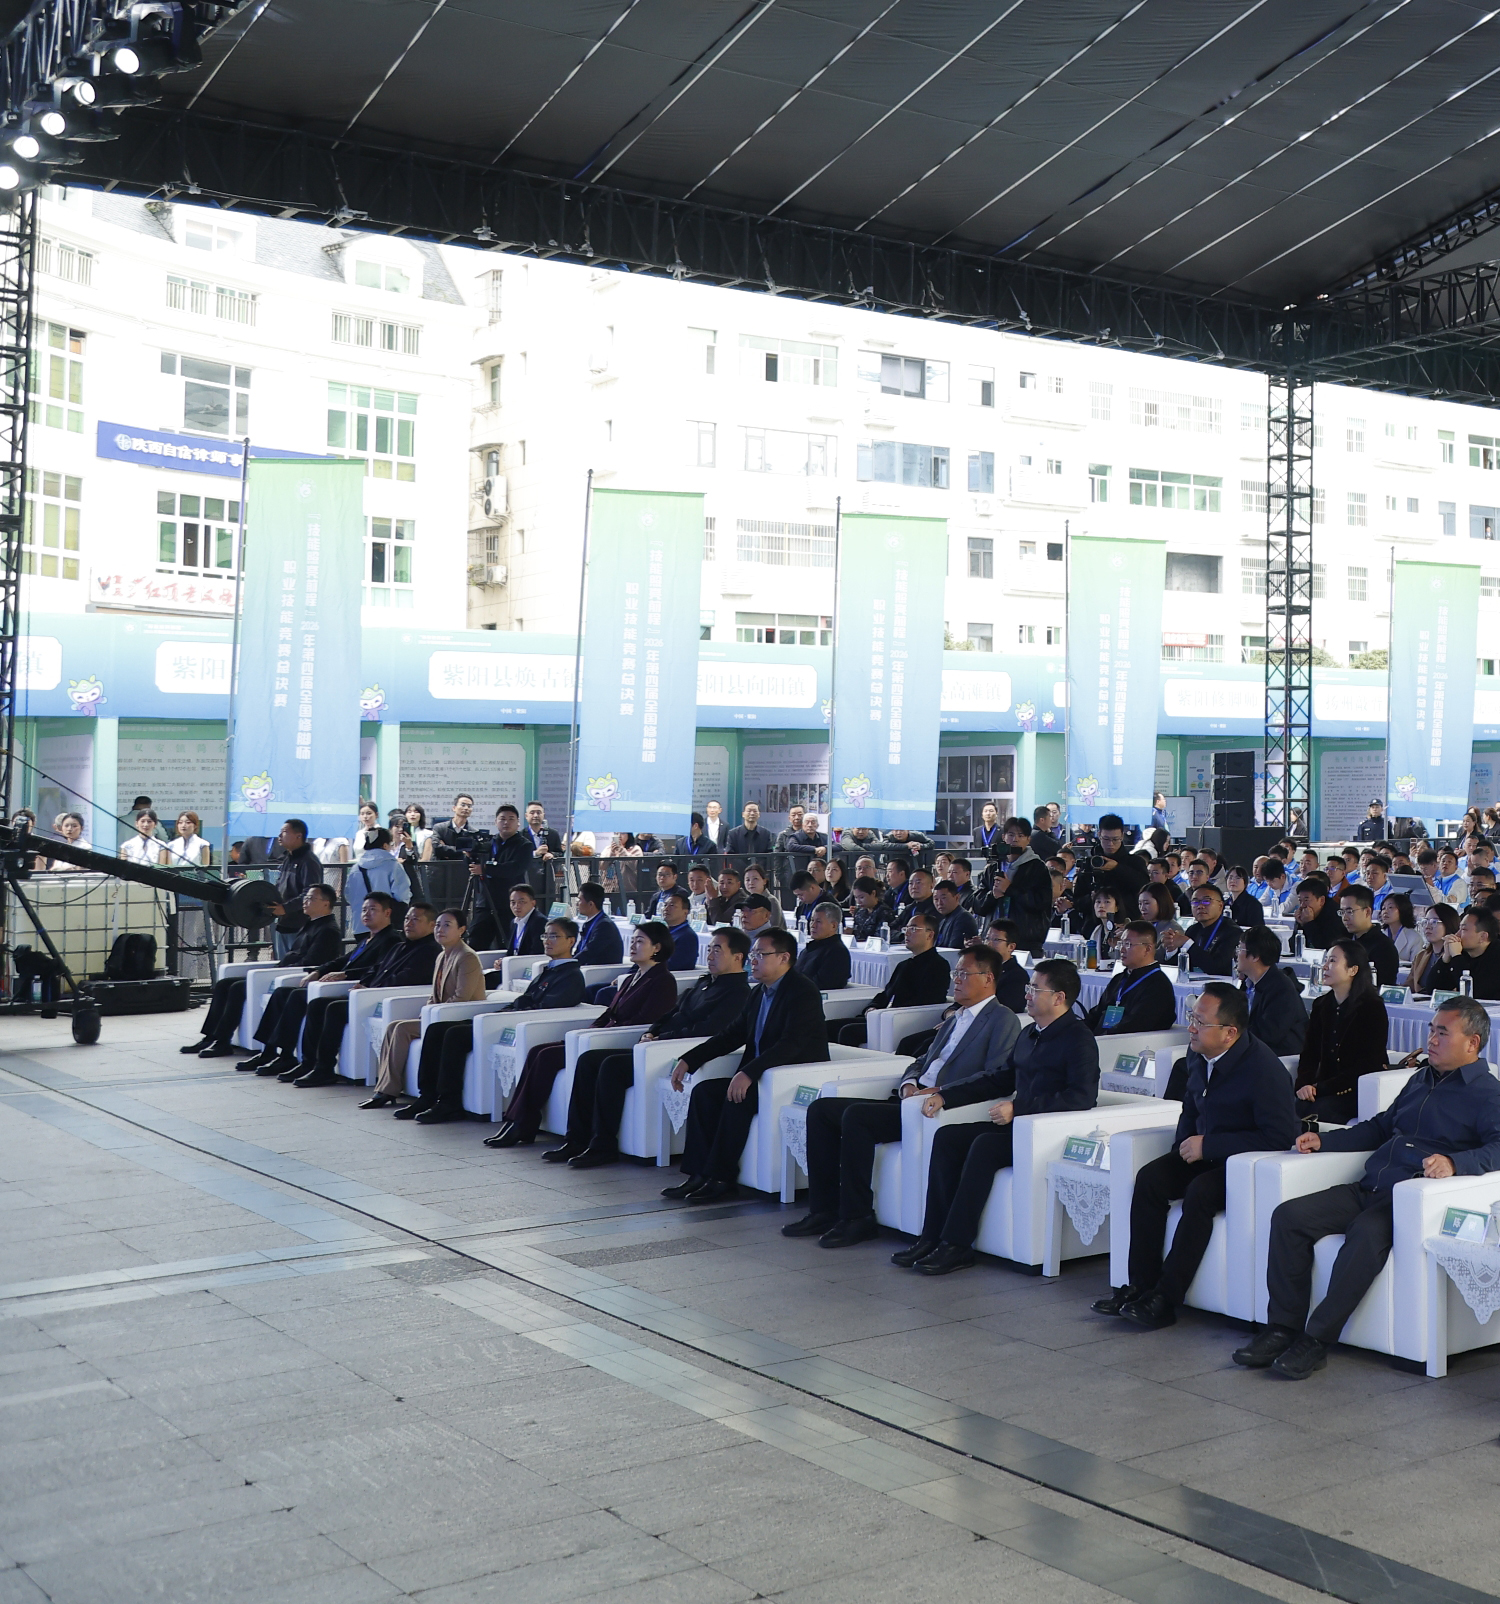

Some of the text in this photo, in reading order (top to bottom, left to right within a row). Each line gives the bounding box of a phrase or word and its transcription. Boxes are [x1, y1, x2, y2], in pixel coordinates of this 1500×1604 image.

[273, 560, 297, 708] 职业技能竞赛总决赛
[619, 582, 639, 716] 职业技能竞赛总决赛
[941, 681, 1002, 701] 高滩镇
